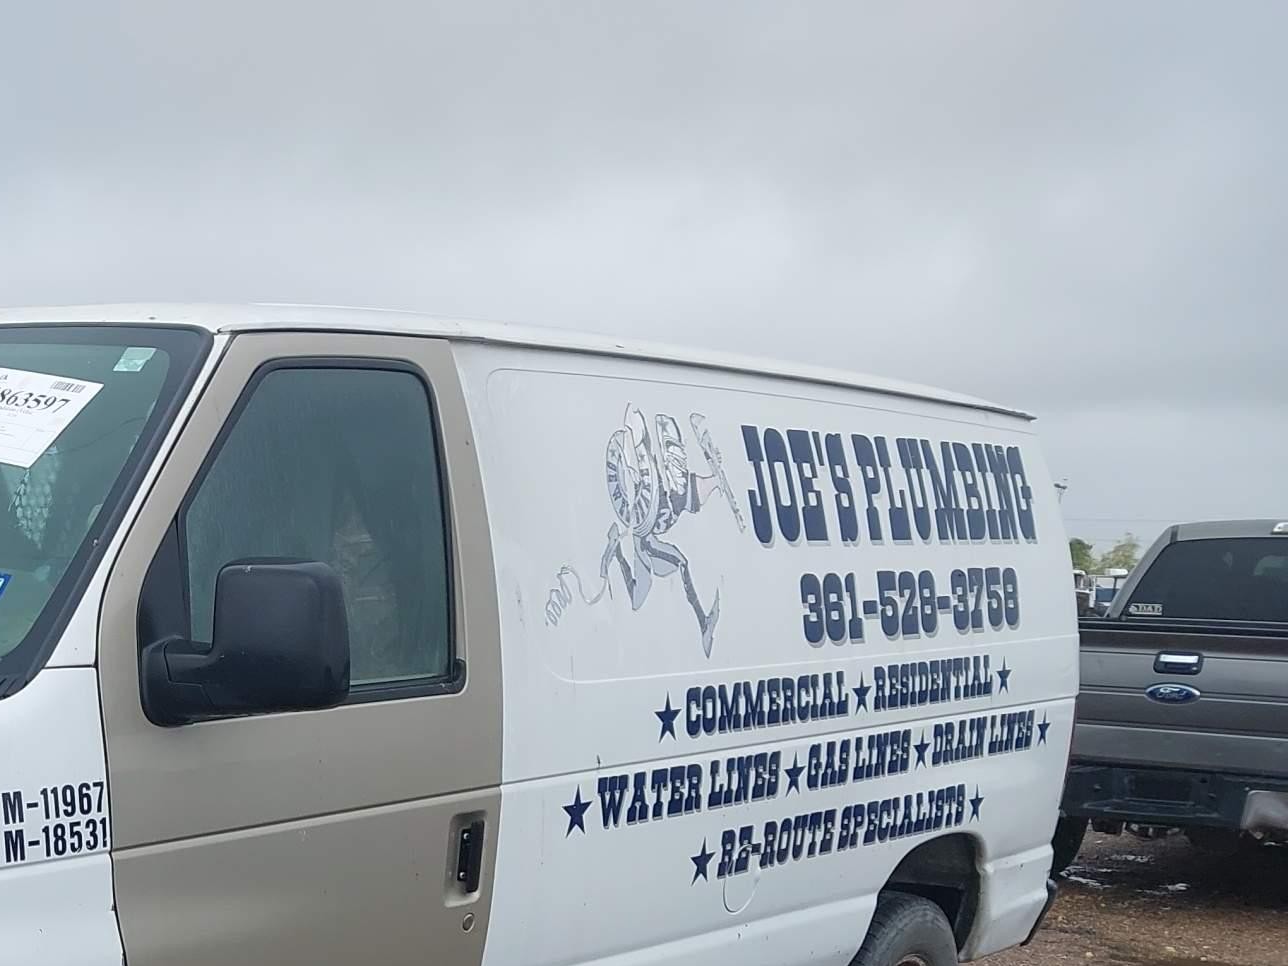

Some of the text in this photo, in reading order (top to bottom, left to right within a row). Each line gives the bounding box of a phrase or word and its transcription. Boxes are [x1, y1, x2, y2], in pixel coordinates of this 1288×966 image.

[741, 424, 859, 546] JOE'S
[850, 433, 1038, 545] PLUMBING
[799, 567, 1020, 648] 361-528-3758
[685, 654, 994, 739] COMMERCIAL RESIDENTIAL
[1, 781, 105, 826] M-11967
[596, 709, 1036, 830] WATER LINES GAS LINES DRAIN LINES
[3, 817, 109, 864] M-18531
[716, 783, 967, 880] RE-ROUTE SPECIALISTS
